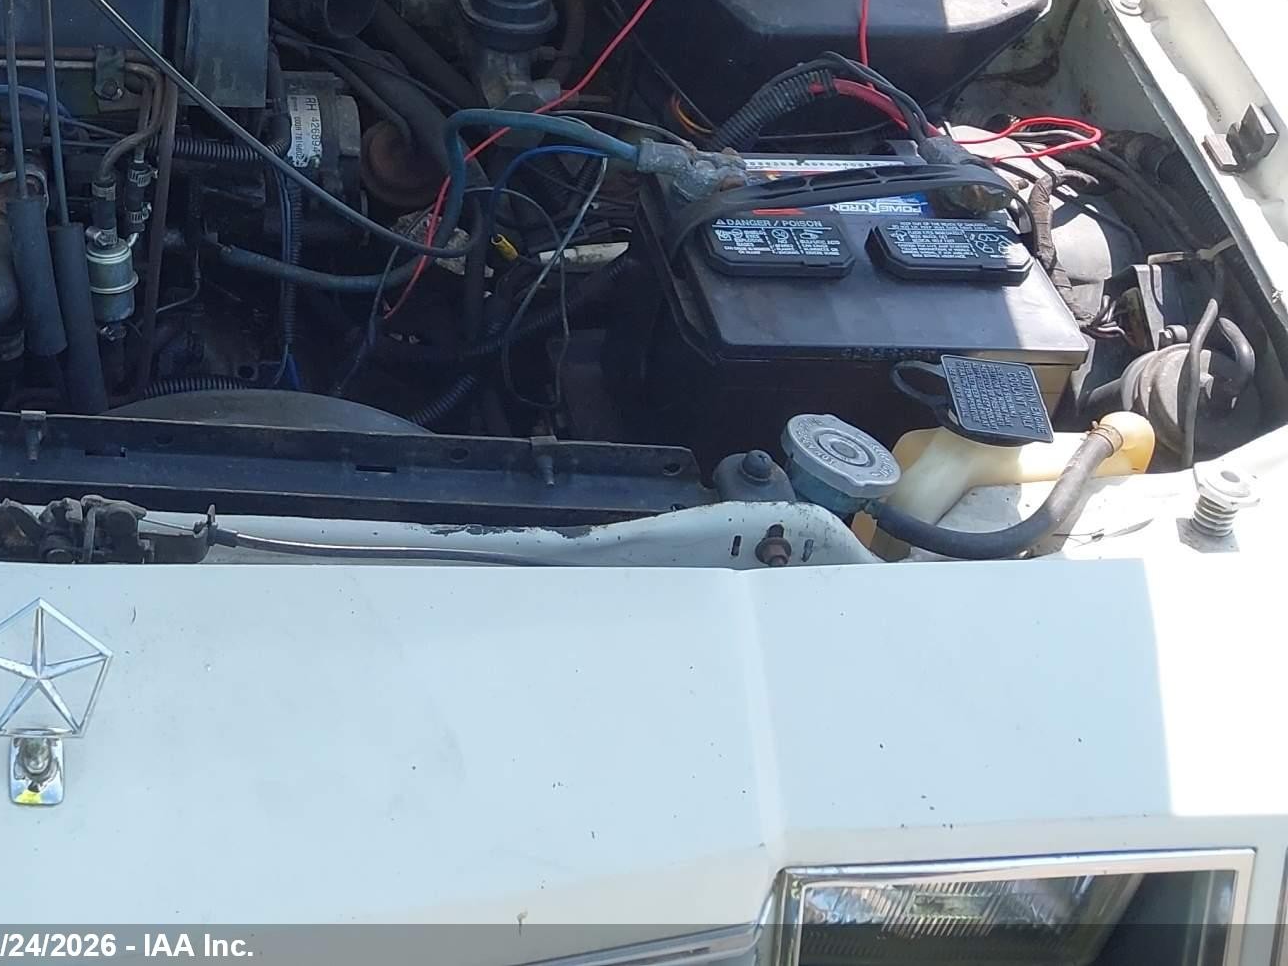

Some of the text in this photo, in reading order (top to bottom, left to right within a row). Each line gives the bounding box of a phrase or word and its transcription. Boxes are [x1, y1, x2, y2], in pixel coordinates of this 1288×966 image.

[726, 218, 771, 227] DANGER
[829, 201, 922, 214] POWERTRON
[1007, 372, 1034, 430] COOLANT ONLY
[1018, 370, 1047, 434] CAUTION ENGINE
